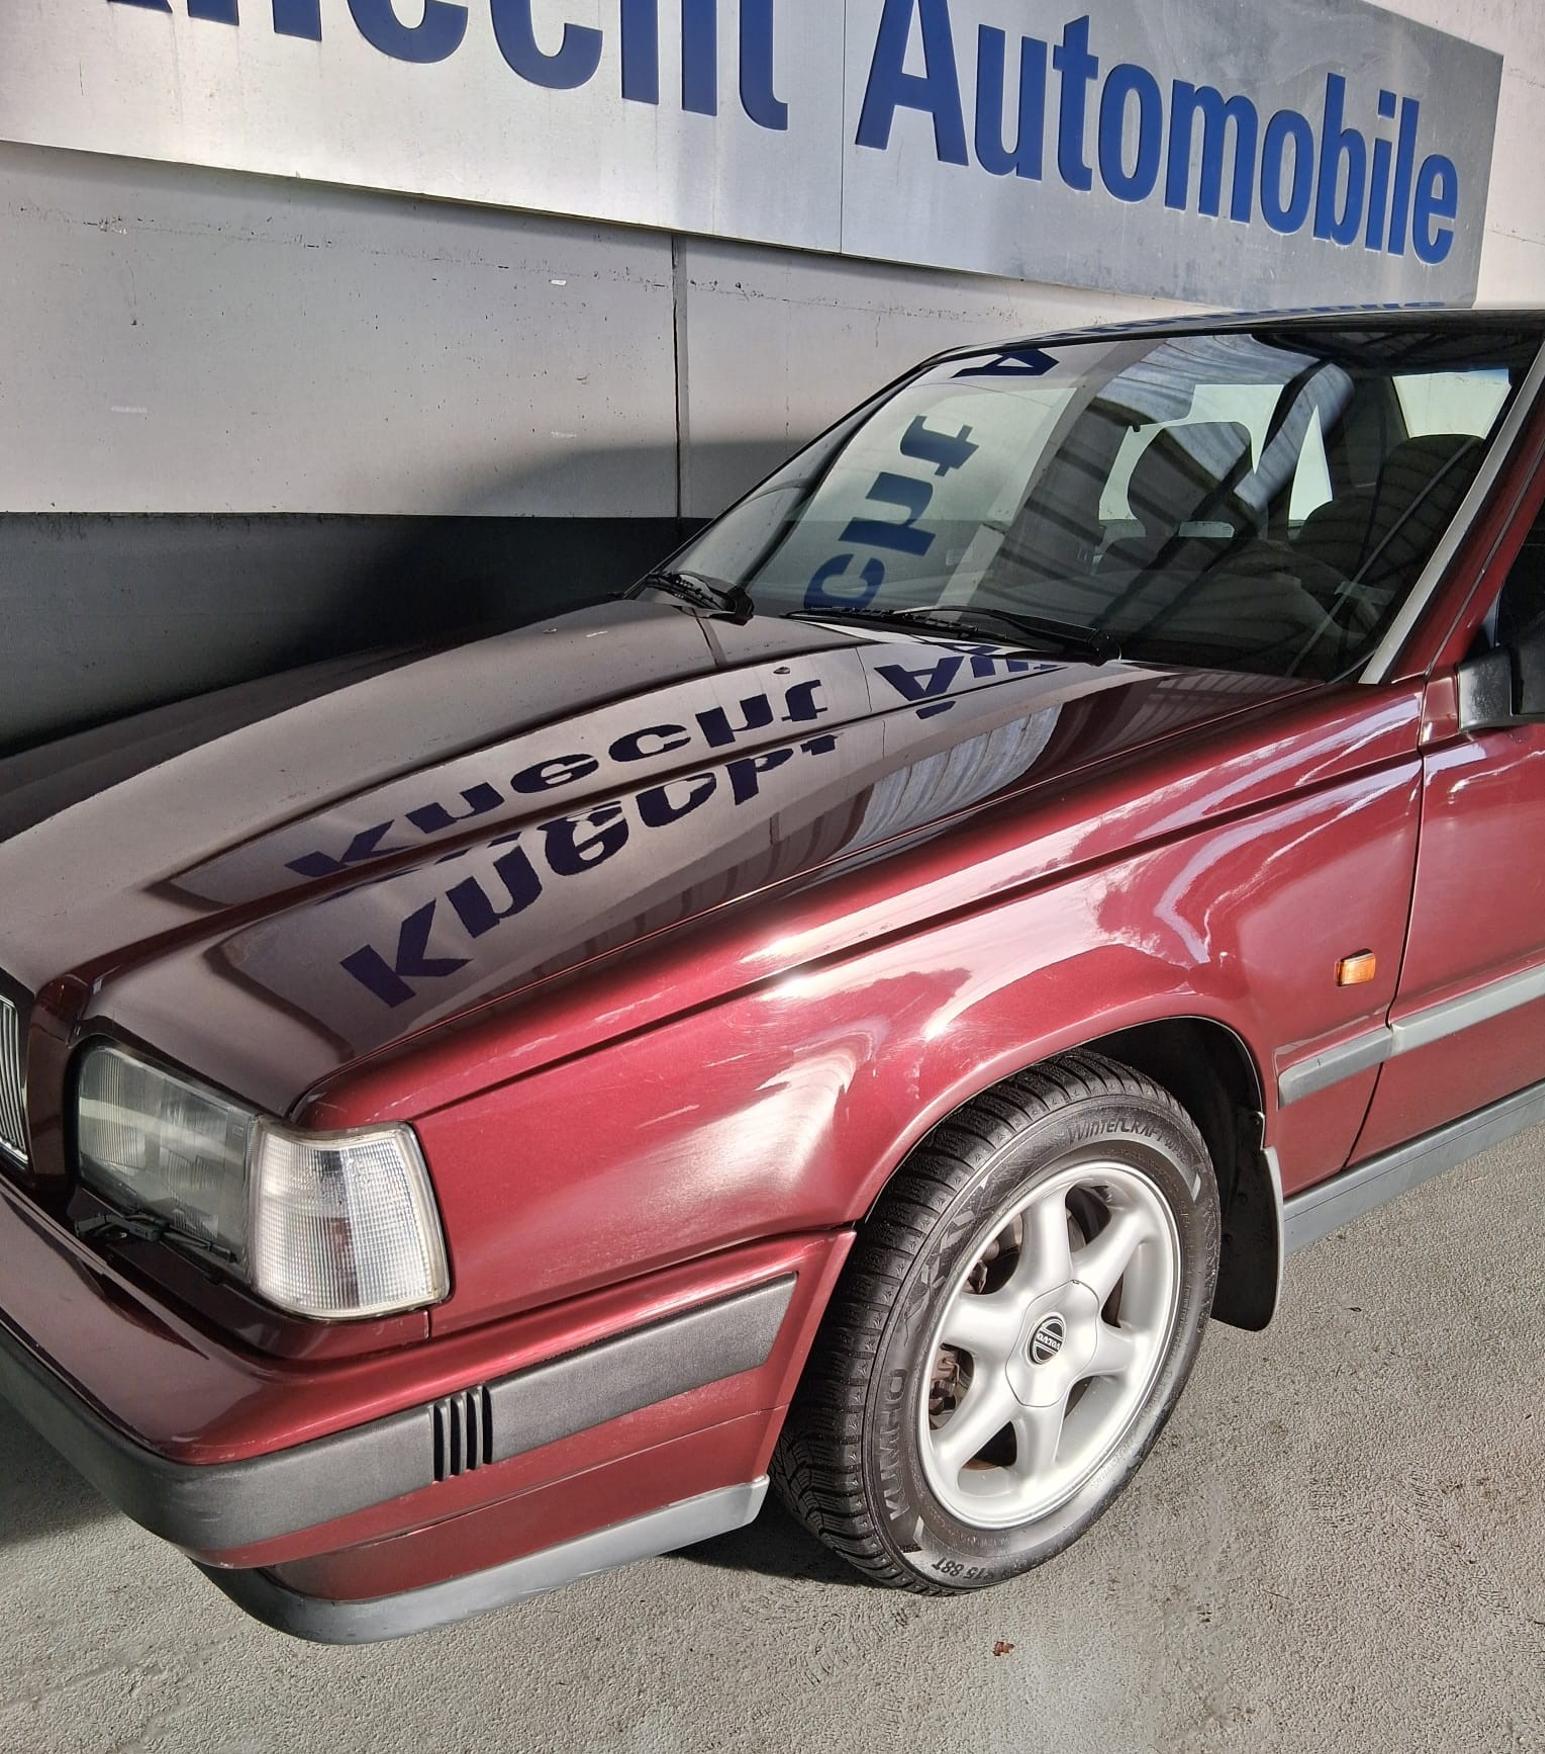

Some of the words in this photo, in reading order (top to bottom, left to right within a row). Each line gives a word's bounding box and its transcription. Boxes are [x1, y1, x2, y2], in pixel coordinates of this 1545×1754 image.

[855, 0, 1458, 265] Automobile
[1036, 1332, 1061, 1350] VOLVO
[879, 1368, 911, 1521] KUMHO
[931, 1557, 965, 1578] 88T
